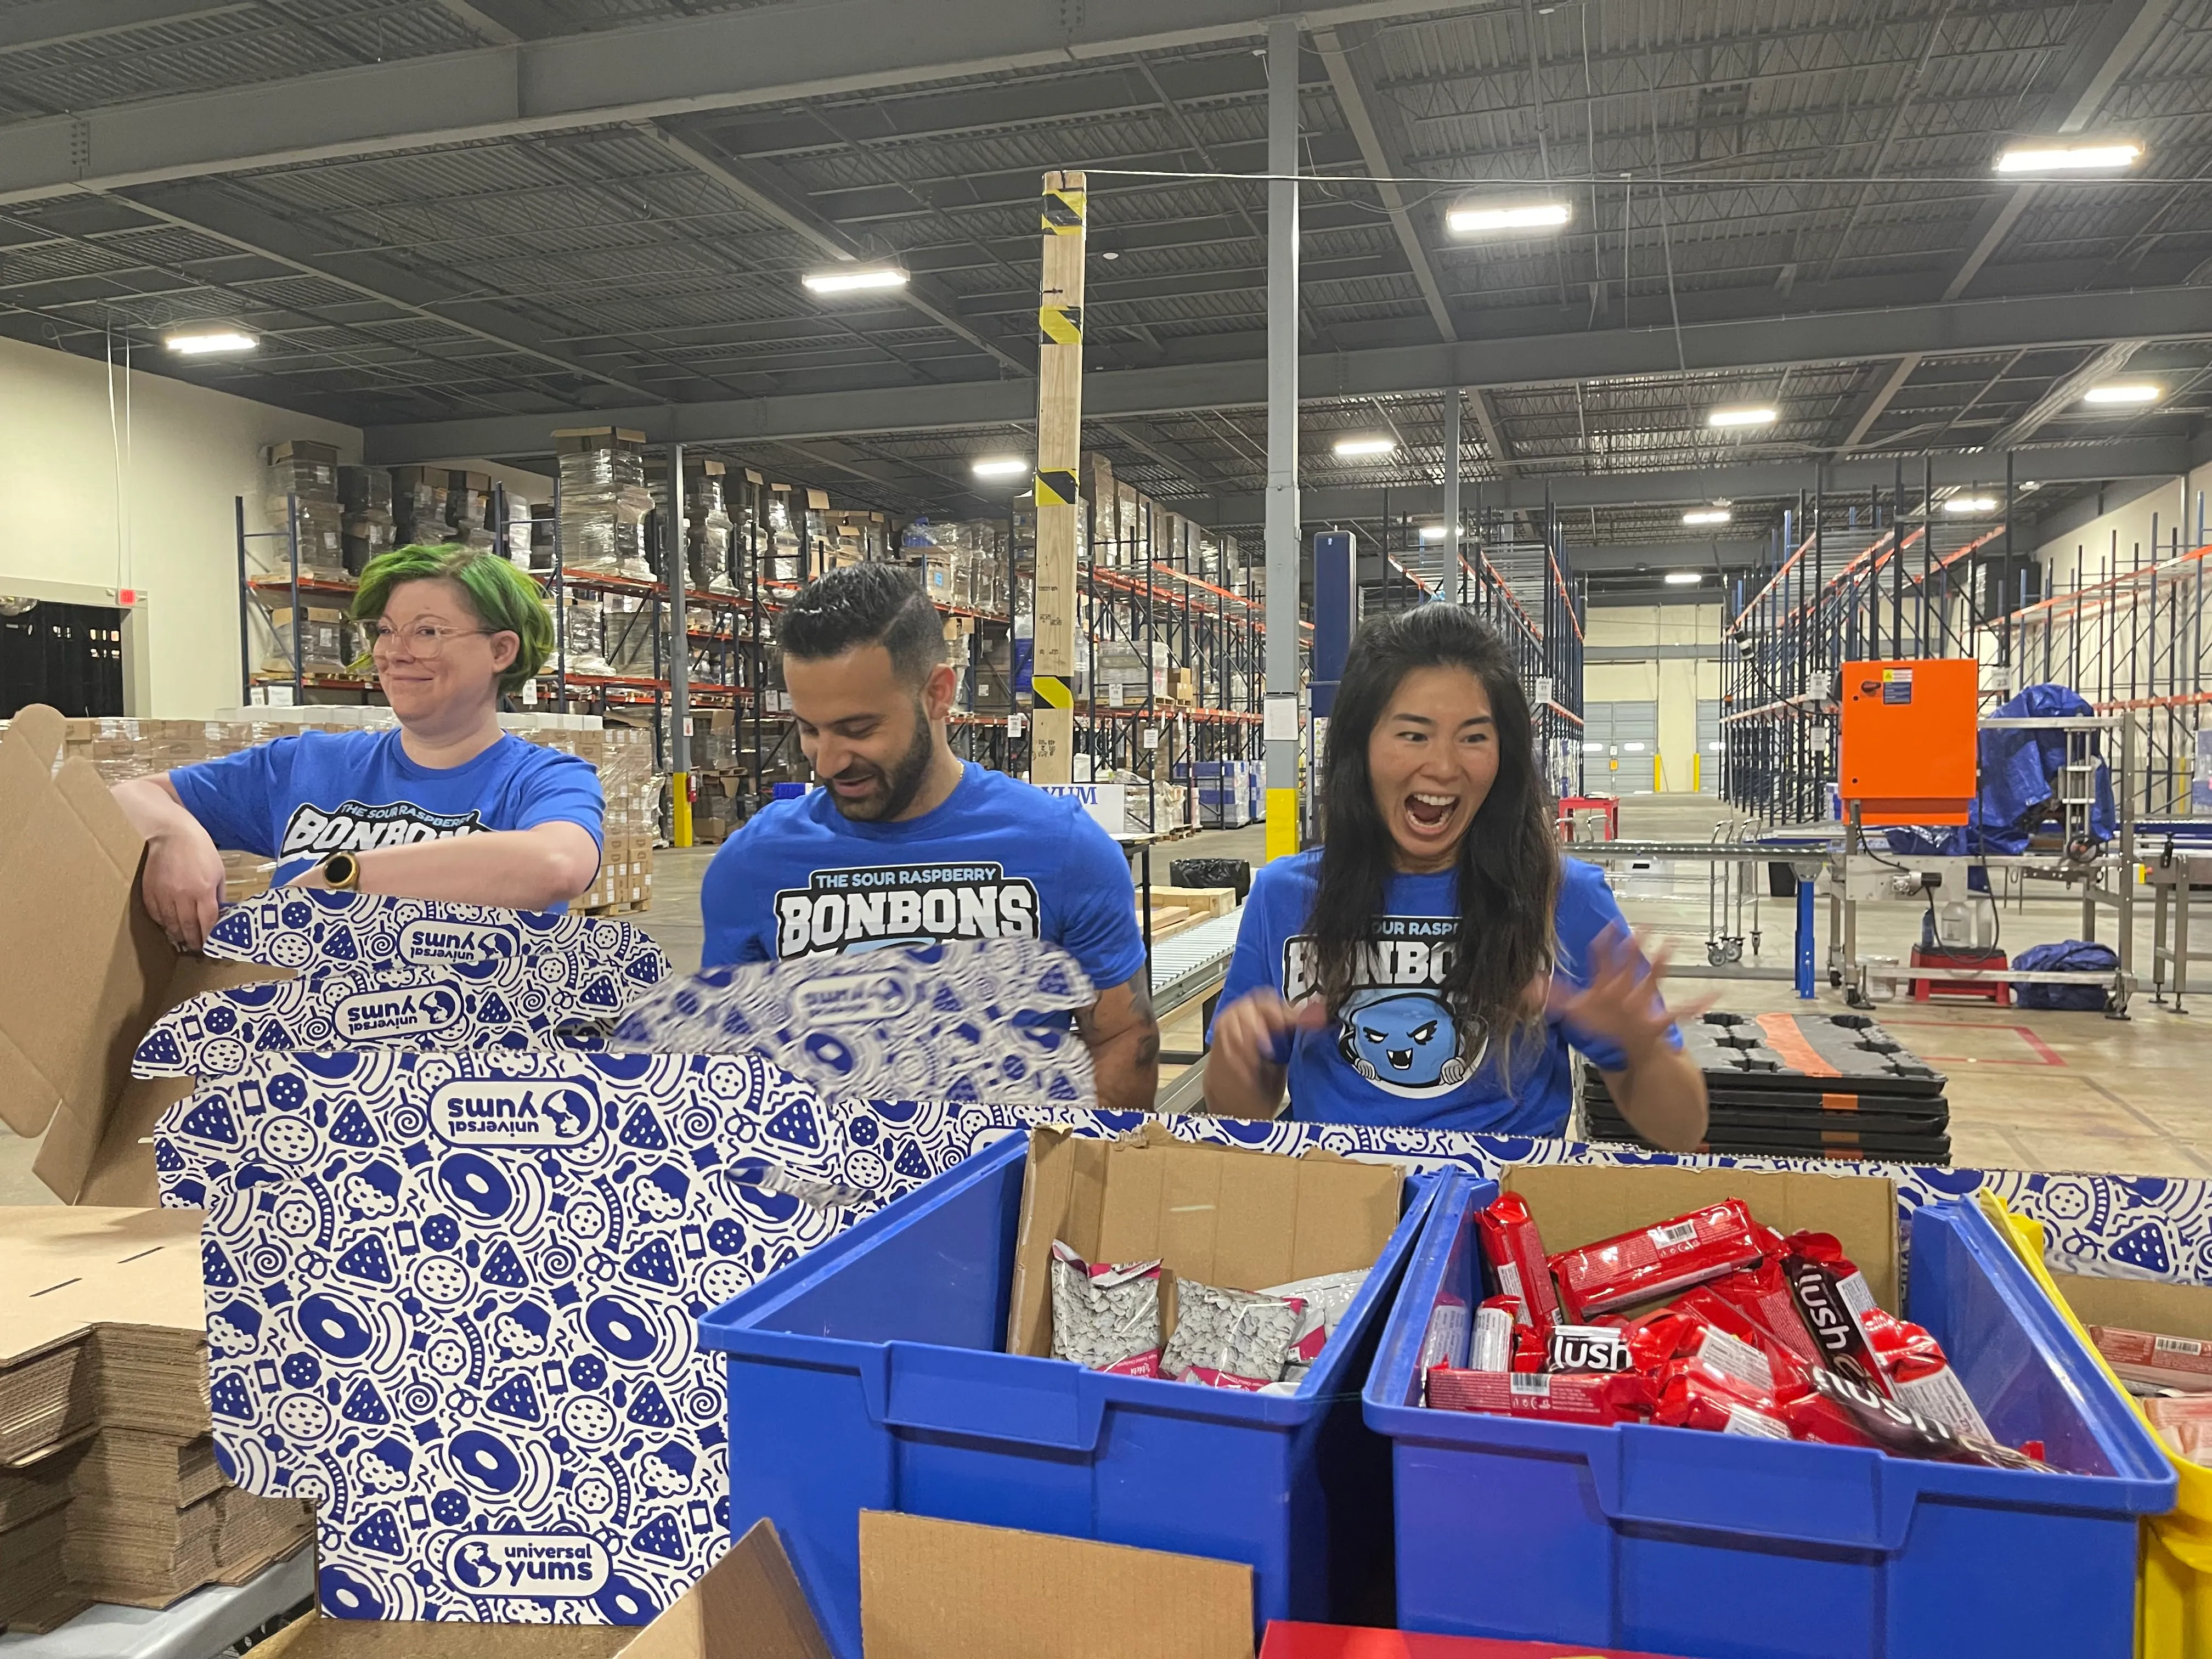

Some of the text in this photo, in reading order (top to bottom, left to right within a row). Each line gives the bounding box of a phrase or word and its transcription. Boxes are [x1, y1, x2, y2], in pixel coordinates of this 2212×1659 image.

[340, 804, 366, 817] THE
[369, 805, 398, 819] SOUR
[282, 808, 484, 854] BONBO
[816, 867, 996, 889] THE SOUR RASPBERRY
[781, 885, 1034, 957] BONBONS
[1408, 922, 1458, 936] RASP
[413, 931, 476, 950] yums
[410, 947, 475, 962] universal
[348, 995, 417, 1022] yums
[348, 1015, 418, 1035] universal
[447, 1091, 538, 1119] yums
[448, 1121, 539, 1137] universal
[1799, 1273, 1850, 1349] lush
[1554, 1336, 1633, 1370] lush
[504, 1543, 592, 1559] universal
[505, 1560, 594, 1587] yums
